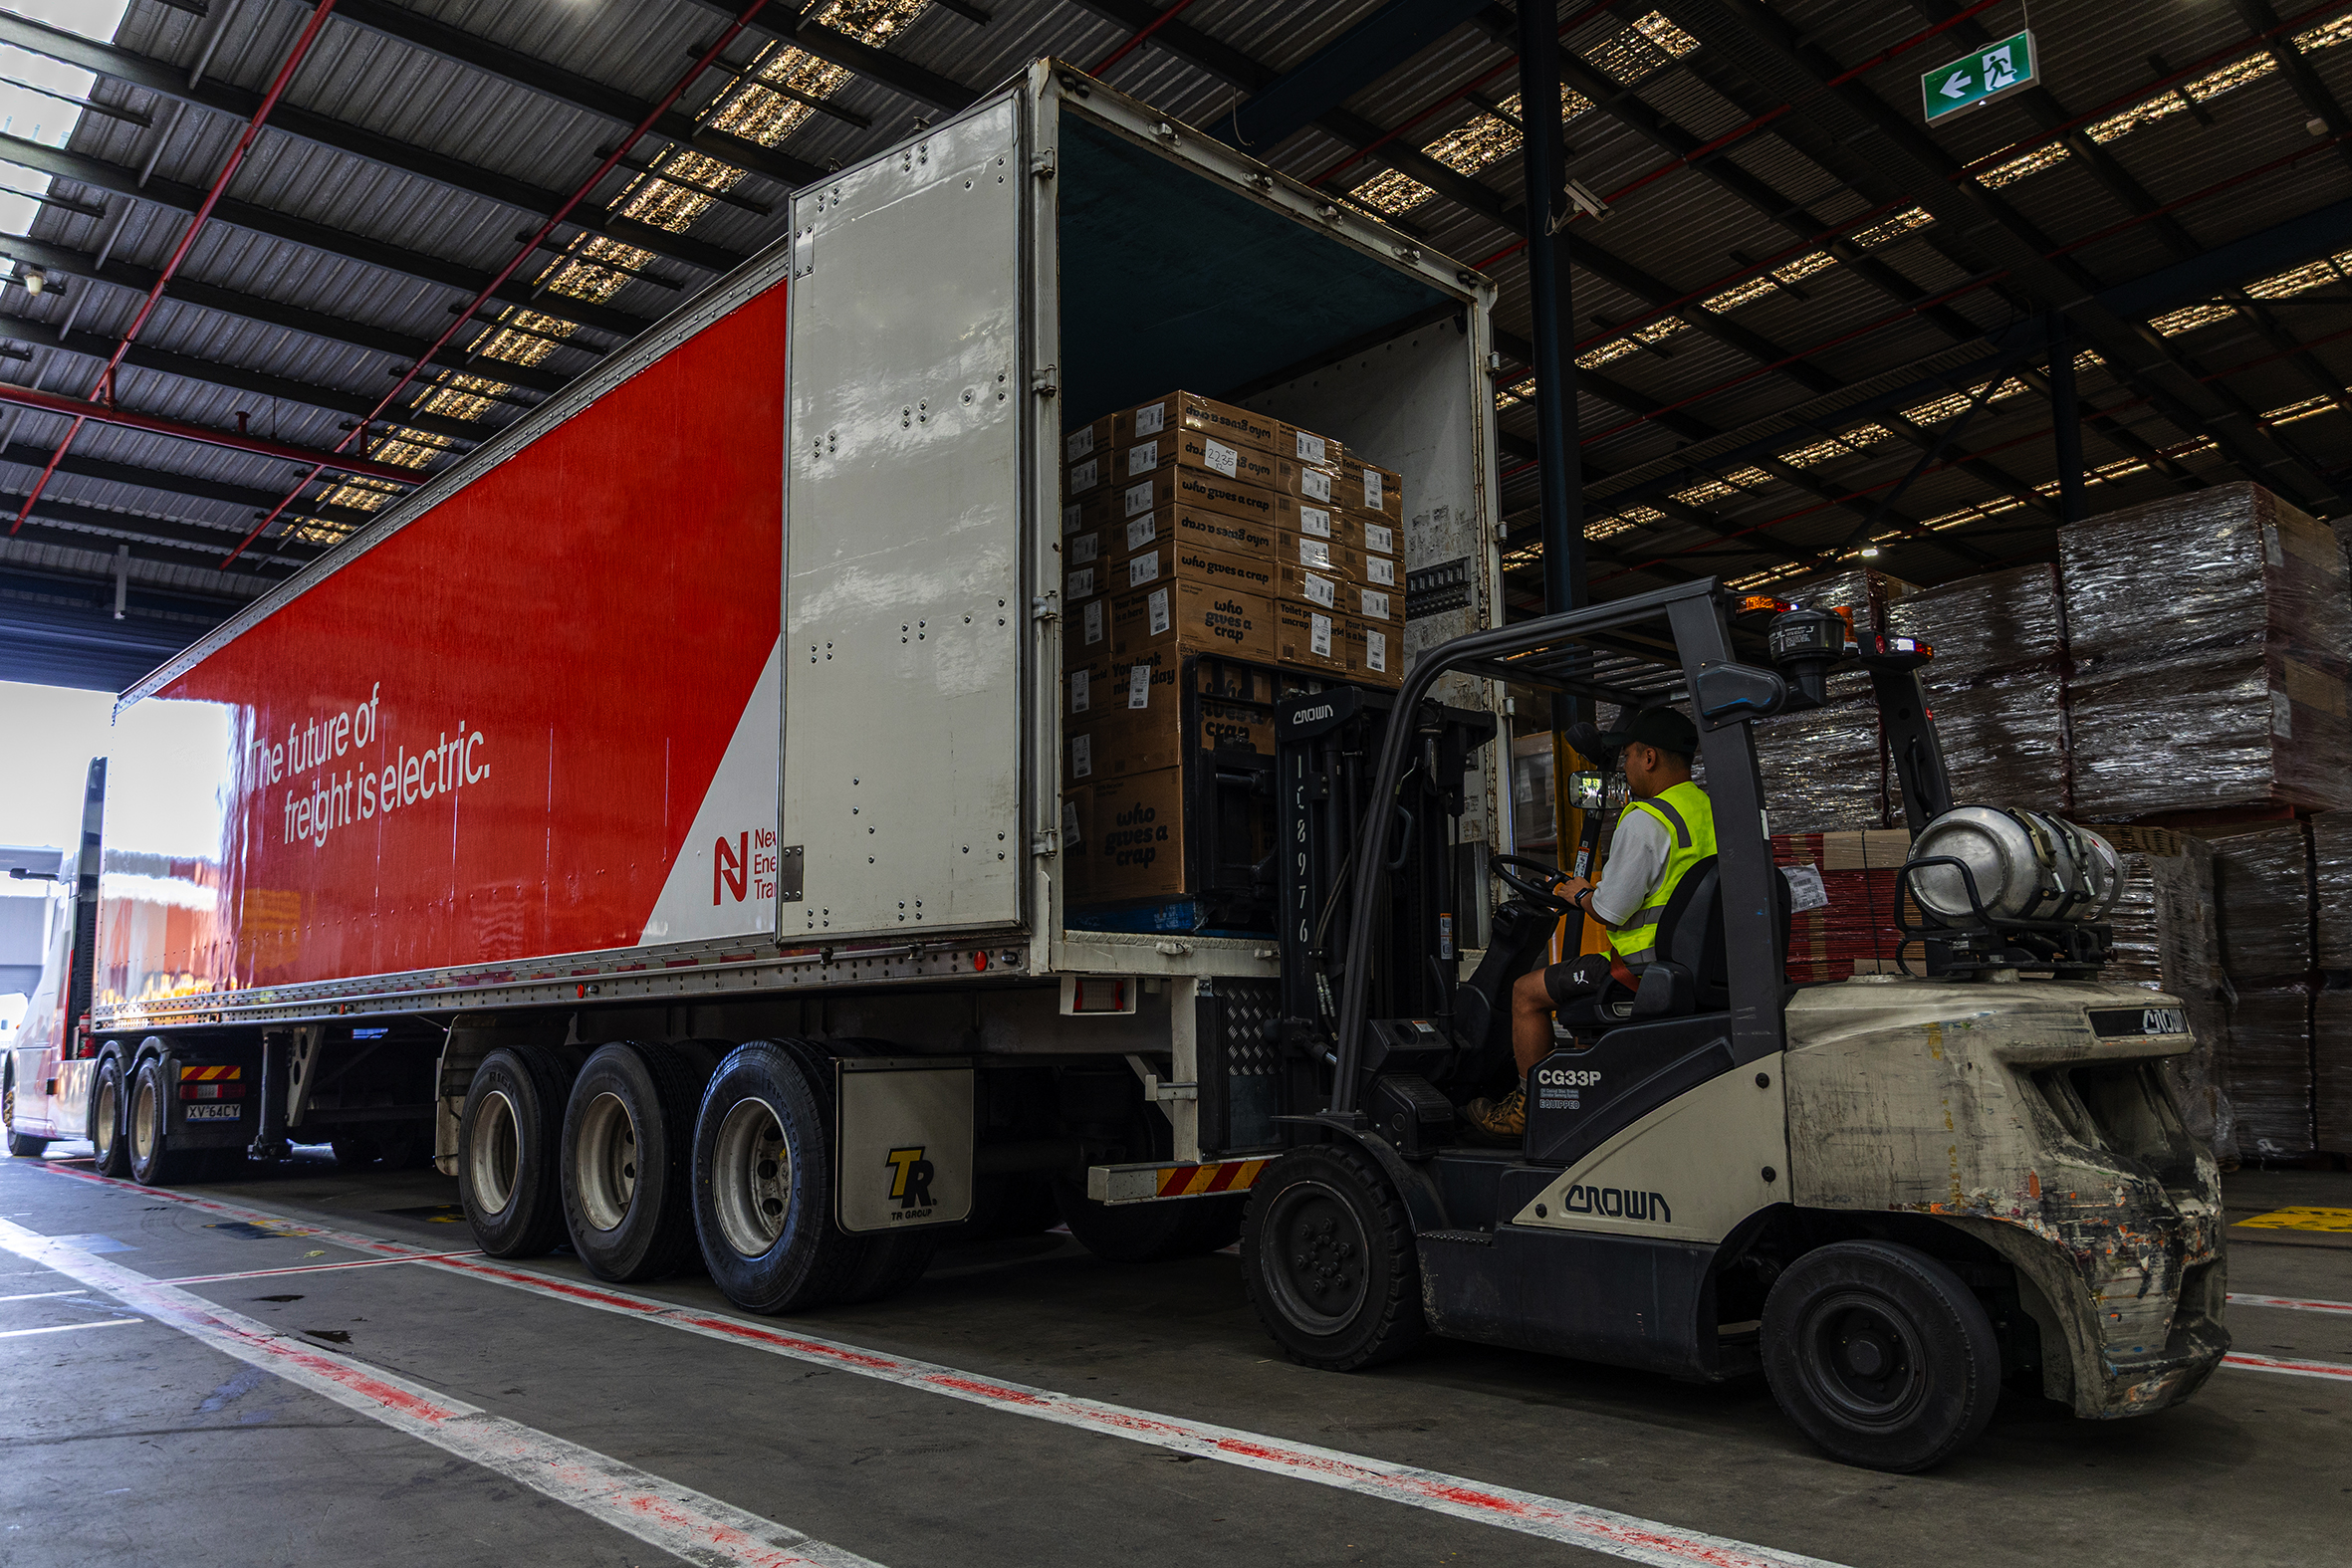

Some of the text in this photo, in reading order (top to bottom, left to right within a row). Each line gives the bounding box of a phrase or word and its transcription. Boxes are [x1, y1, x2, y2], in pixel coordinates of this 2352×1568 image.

[1186, 404, 1210, 420] crap
[1211, 412, 1219, 422] a
[1220, 416, 1248, 430] gives
[1250, 426, 1271, 438] who
[1185, 442, 1270, 476] who rap
[1208, 448, 1234, 466] 2235
[1342, 459, 1390, 482] Toilet to
[1343, 472, 1364, 485] uncra
[1182, 481, 1206, 494] who
[1207, 488, 1237, 502] gives
[1247, 498, 1269, 512] crap
[1182, 517, 1269, 548] who gives a crap
[1182, 556, 1269, 584] who gives a crap
[1215, 599, 1243, 615] who
[1281, 603, 1301, 616] Toilet
[1205, 611, 1252, 630] gives a
[1282, 617, 1344, 637] uncrap orld
[1215, 626, 1243, 644] crap
[1358, 633, 1367, 642] he
[1112, 662, 1133, 677] You
[1113, 669, 1175, 695] nic day
[1293, 704, 1333, 725] CROWN
[250, 681, 379, 792] The future of
[285, 720, 490, 847] freight is electric.
[1116, 802, 1155, 826] who
[1104, 825, 1168, 856] gives a
[1116, 846, 1155, 869] crap
[1537, 1069, 1601, 1086] CG33P
[1539, 1099, 1580, 1109] EQUIPPED
[885, 1146, 934, 1209] TR
[1565, 1185, 1671, 1223] CROWN
[891, 1209, 932, 1221] TR GROUP
